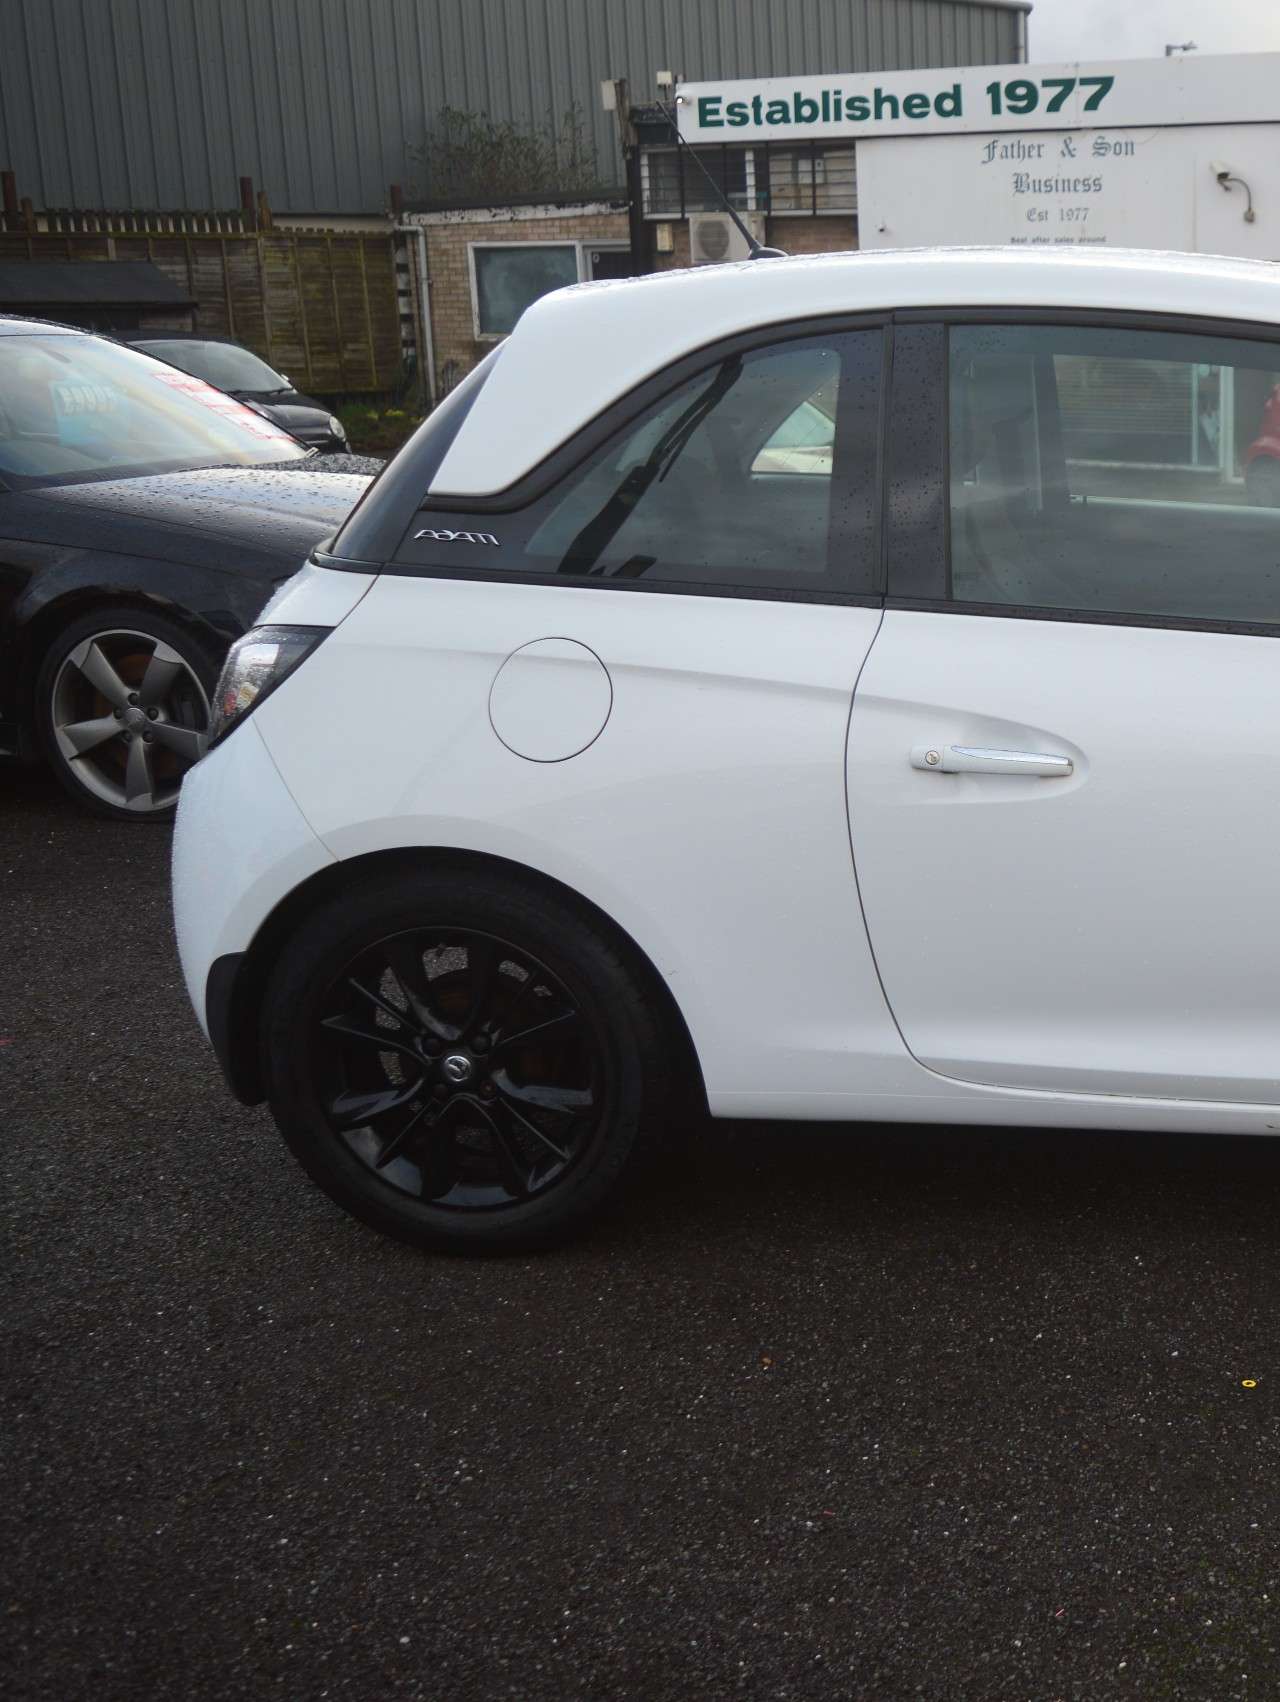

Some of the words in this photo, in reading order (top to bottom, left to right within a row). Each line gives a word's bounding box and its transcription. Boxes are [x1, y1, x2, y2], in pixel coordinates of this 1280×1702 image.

[697, 83, 963, 129] Established
[985, 75, 1115, 116] 1977
[981, 139, 1045, 164] Father
[1060, 136, 1077, 158] &
[1092, 135, 1135, 158] Son
[1012, 172, 1103, 194] Business
[1026, 207, 1049, 222] Est
[1060, 207, 1090, 222] 1977
